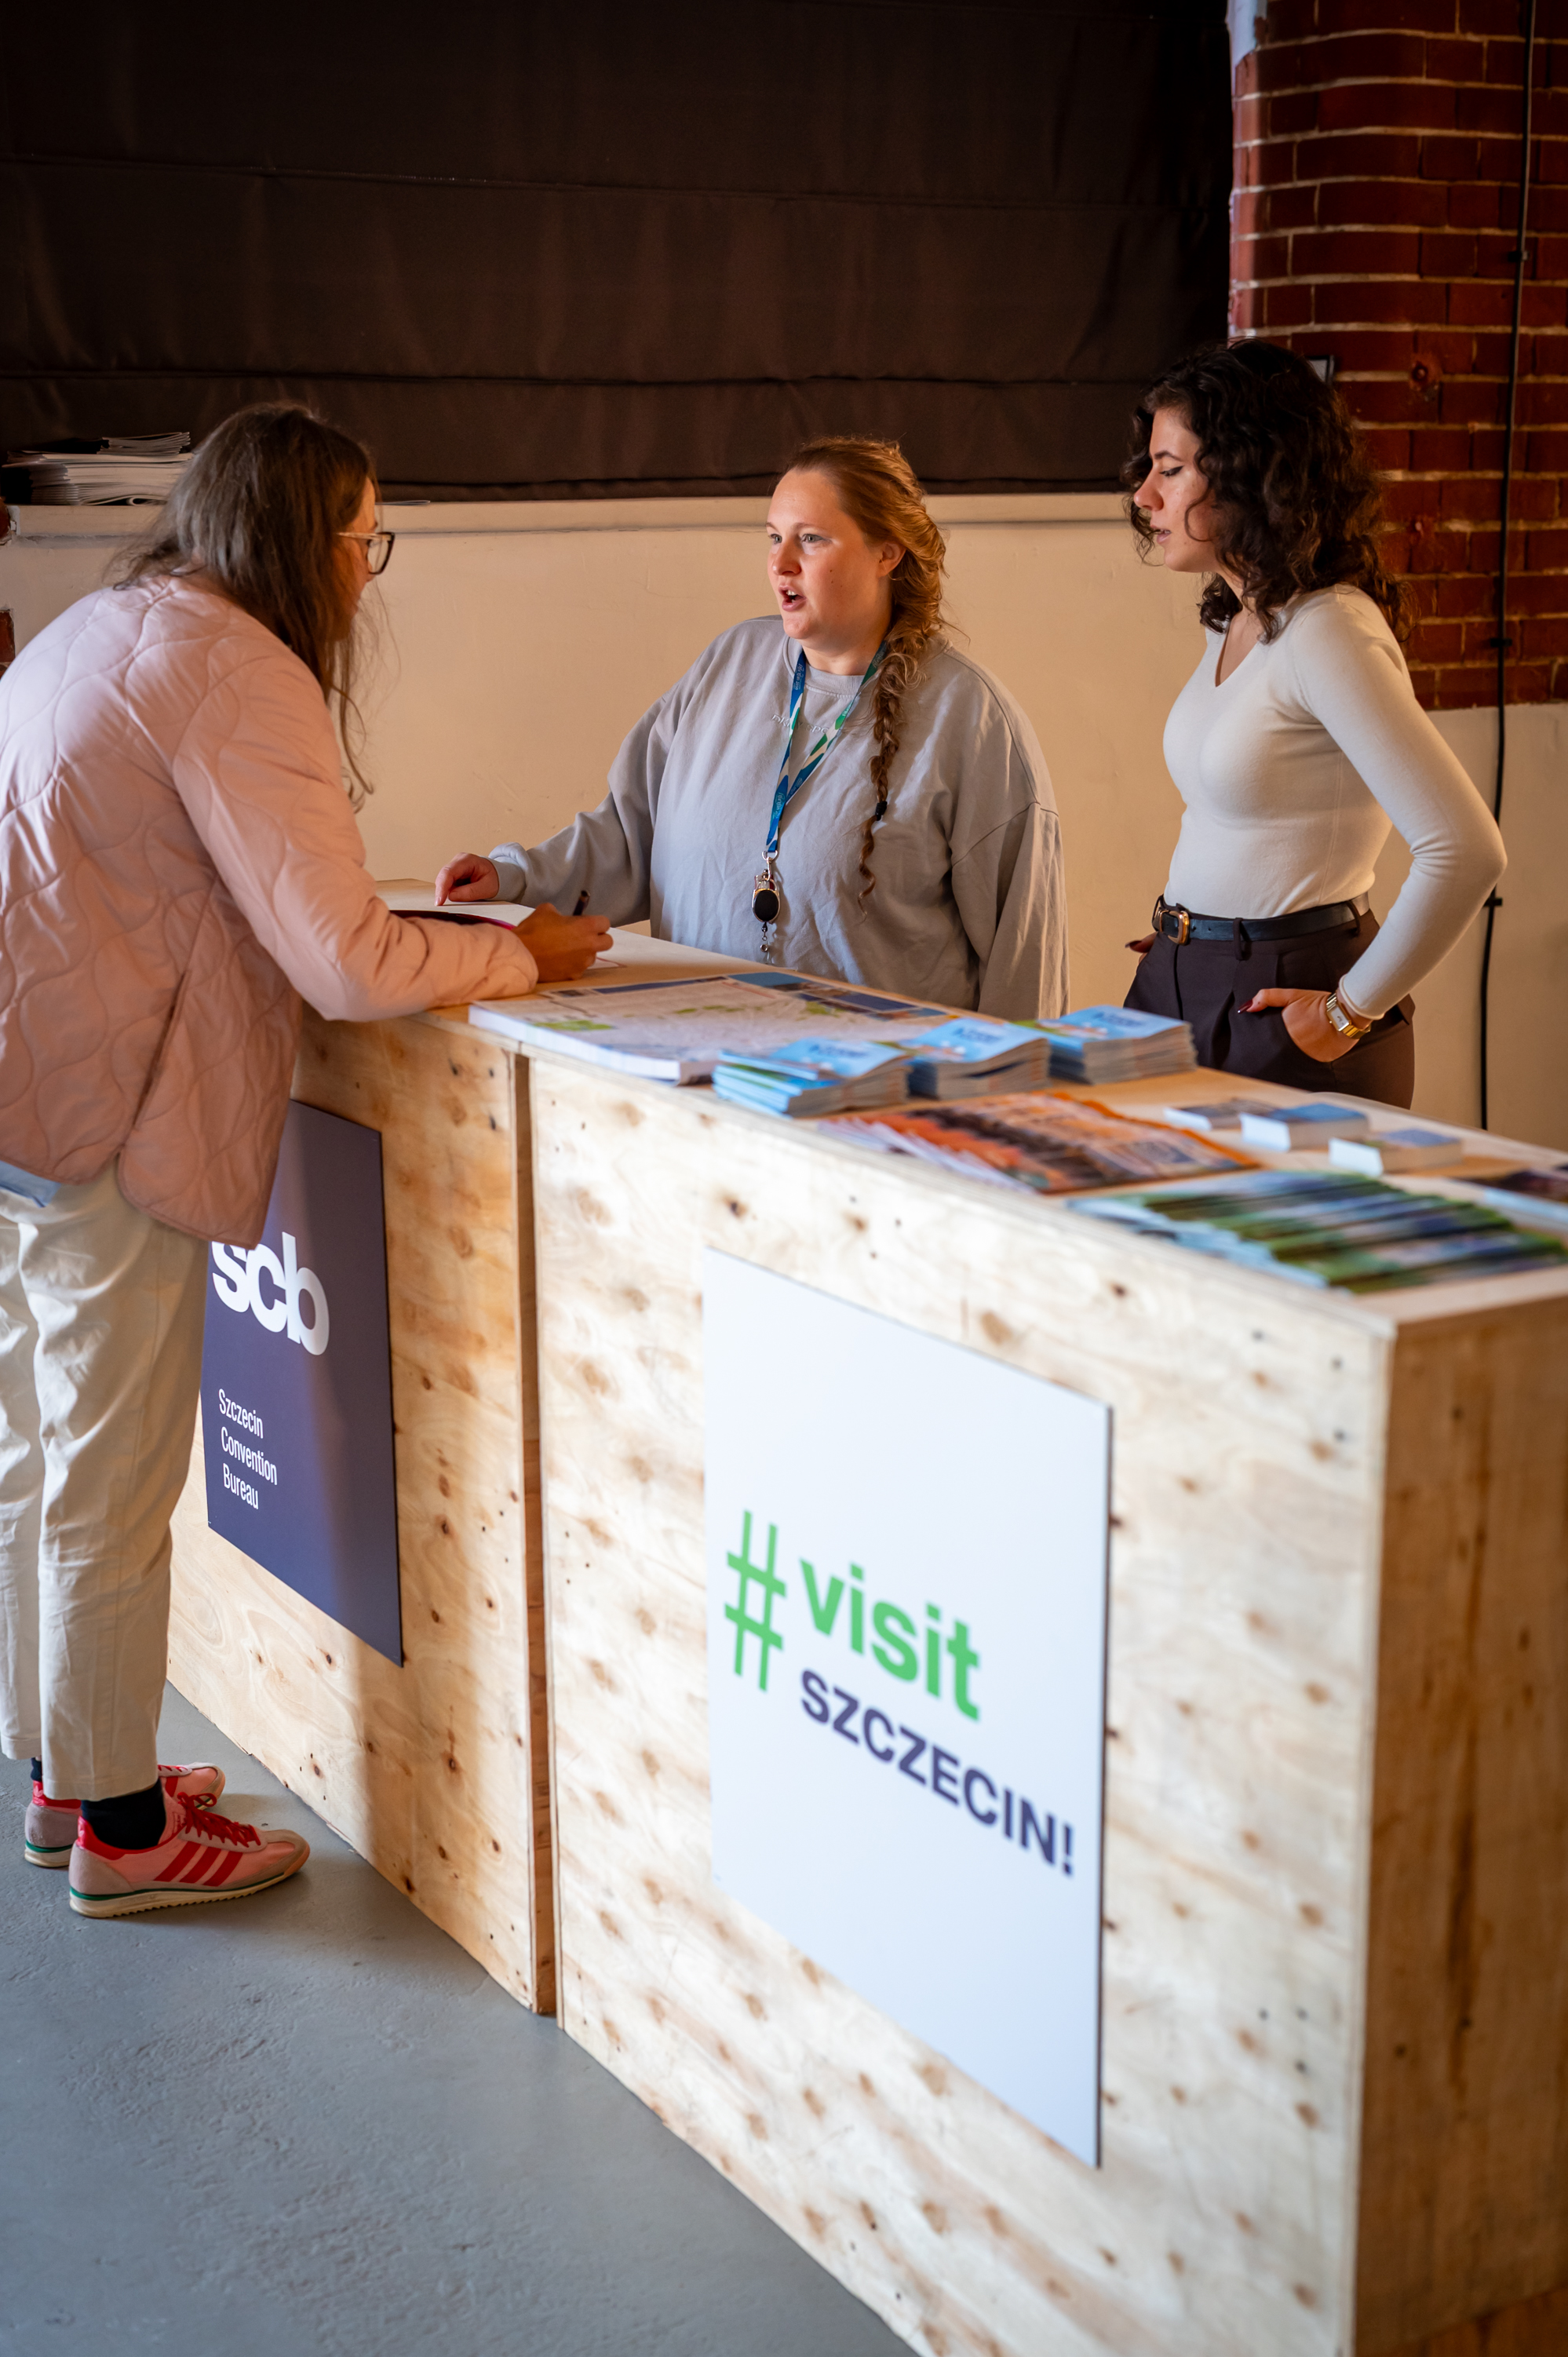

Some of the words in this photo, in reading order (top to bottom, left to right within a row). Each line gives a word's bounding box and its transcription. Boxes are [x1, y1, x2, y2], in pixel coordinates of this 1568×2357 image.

[211, 1231, 330, 1355] scb
[218, 1388, 264, 1439] Szczecin
[221, 1426, 278, 1485] Convention
[223, 1462, 259, 1509] Bureau
[801, 1668, 1073, 1877] SZCZECIN!
